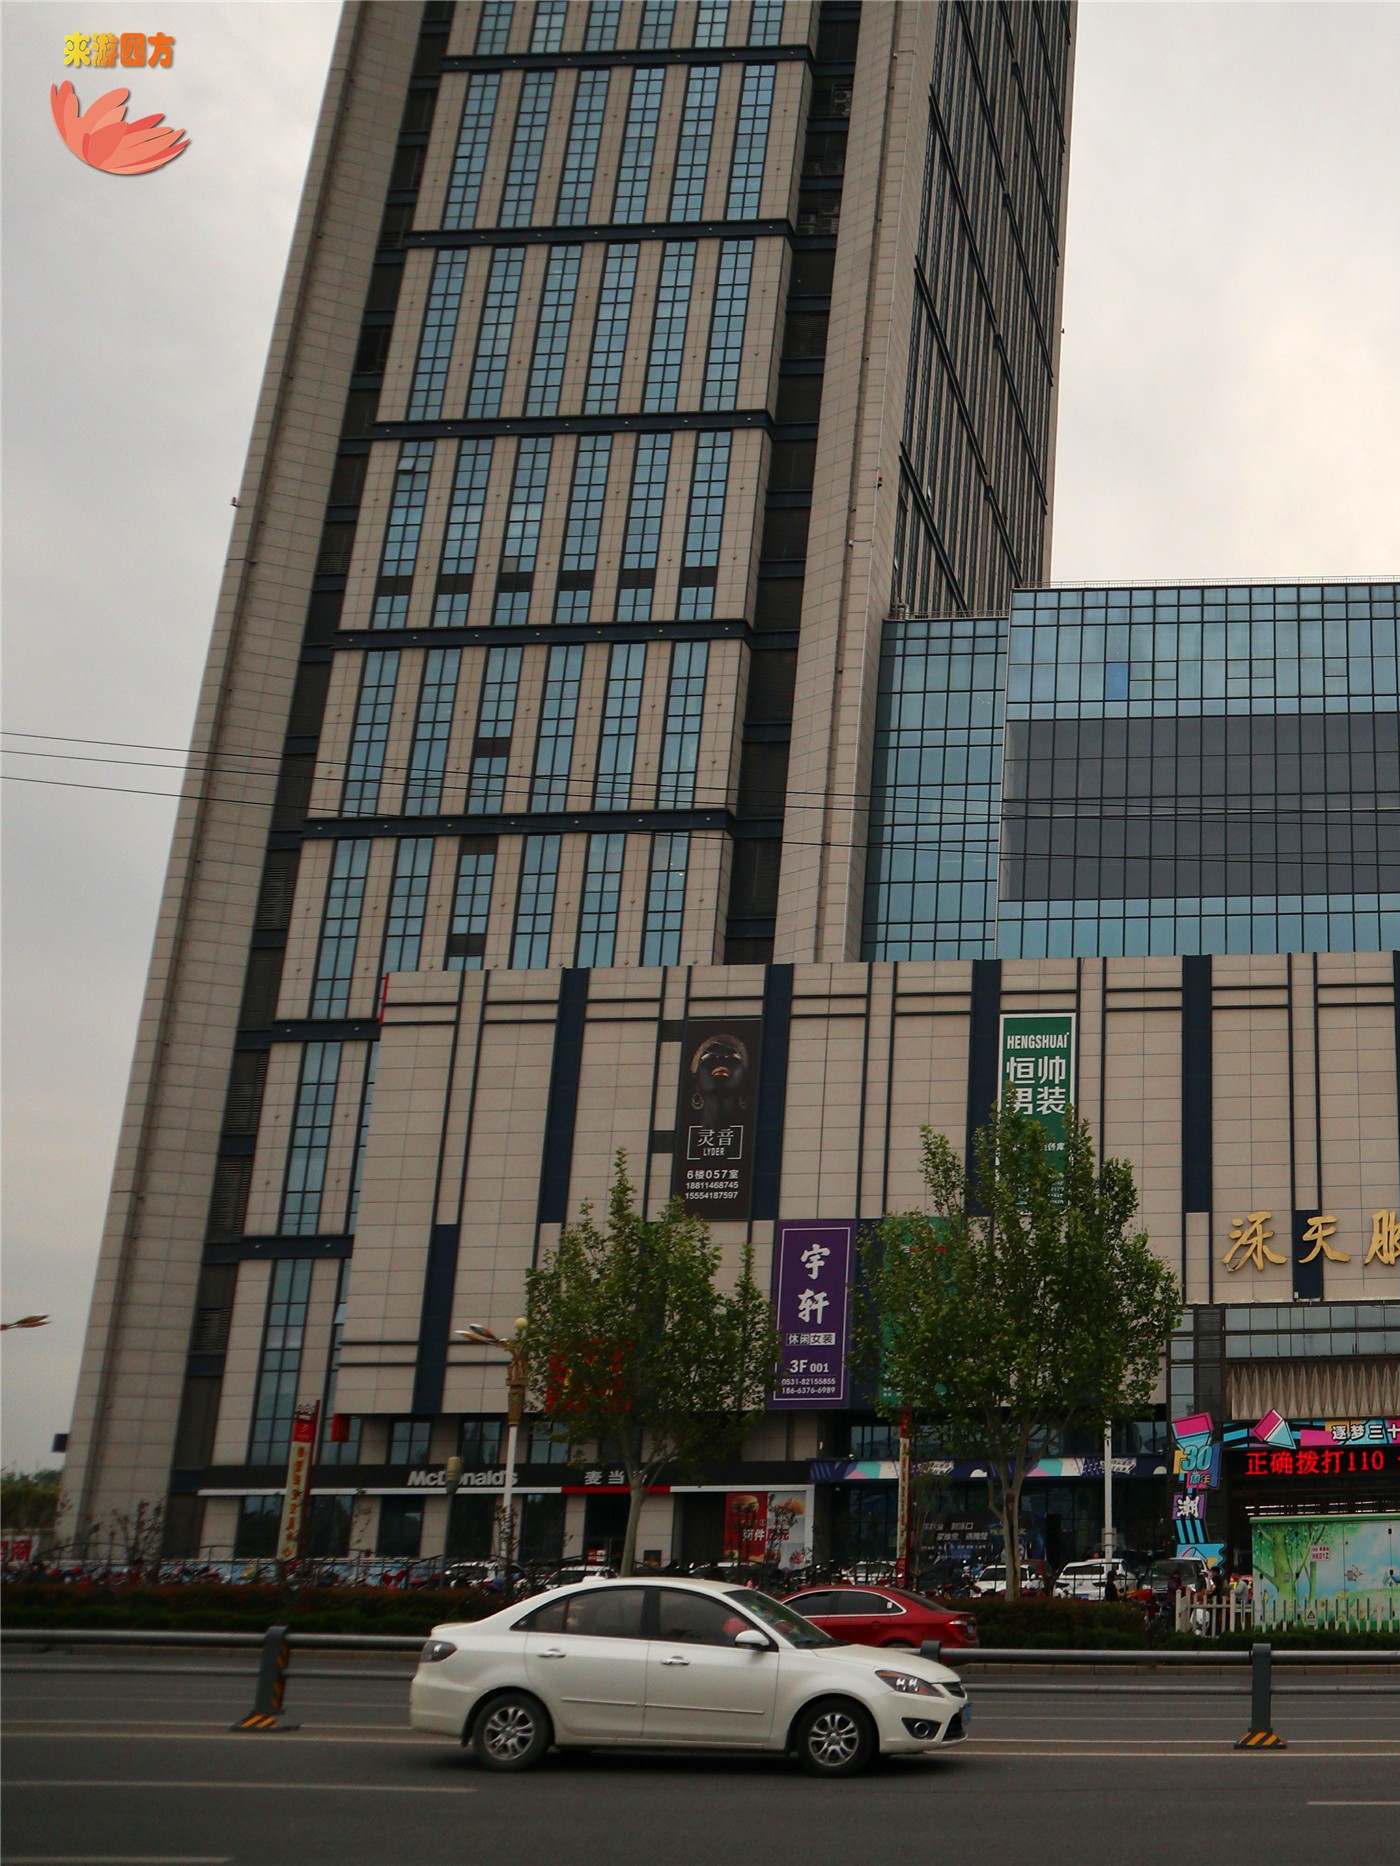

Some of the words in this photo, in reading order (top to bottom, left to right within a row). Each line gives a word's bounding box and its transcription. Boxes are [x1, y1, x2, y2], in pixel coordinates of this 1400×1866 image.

[1007, 1034, 1068, 1050] HENGSHUAI
[1006, 1055, 1066, 1085] 恒帅
[1006, 1086, 1066, 1115] 男装
[697, 1128, 734, 1147] 灵音
[703, 1147, 725, 1156] LYDER
[686, 1169, 739, 1180] 6楼057室
[797, 1243, 831, 1325] 宇轩
[788, 1333, 835, 1345] 休闲女装
[789, 1359, 808, 1373] 3F
[810, 1362, 829, 1373] 001
[1180, 1444, 1213, 1472] 30
[1244, 1450, 1385, 1475] 正确拨打110
[407, 1470, 518, 1487] McDnalds
[584, 1470, 648, 1485] 麦当
